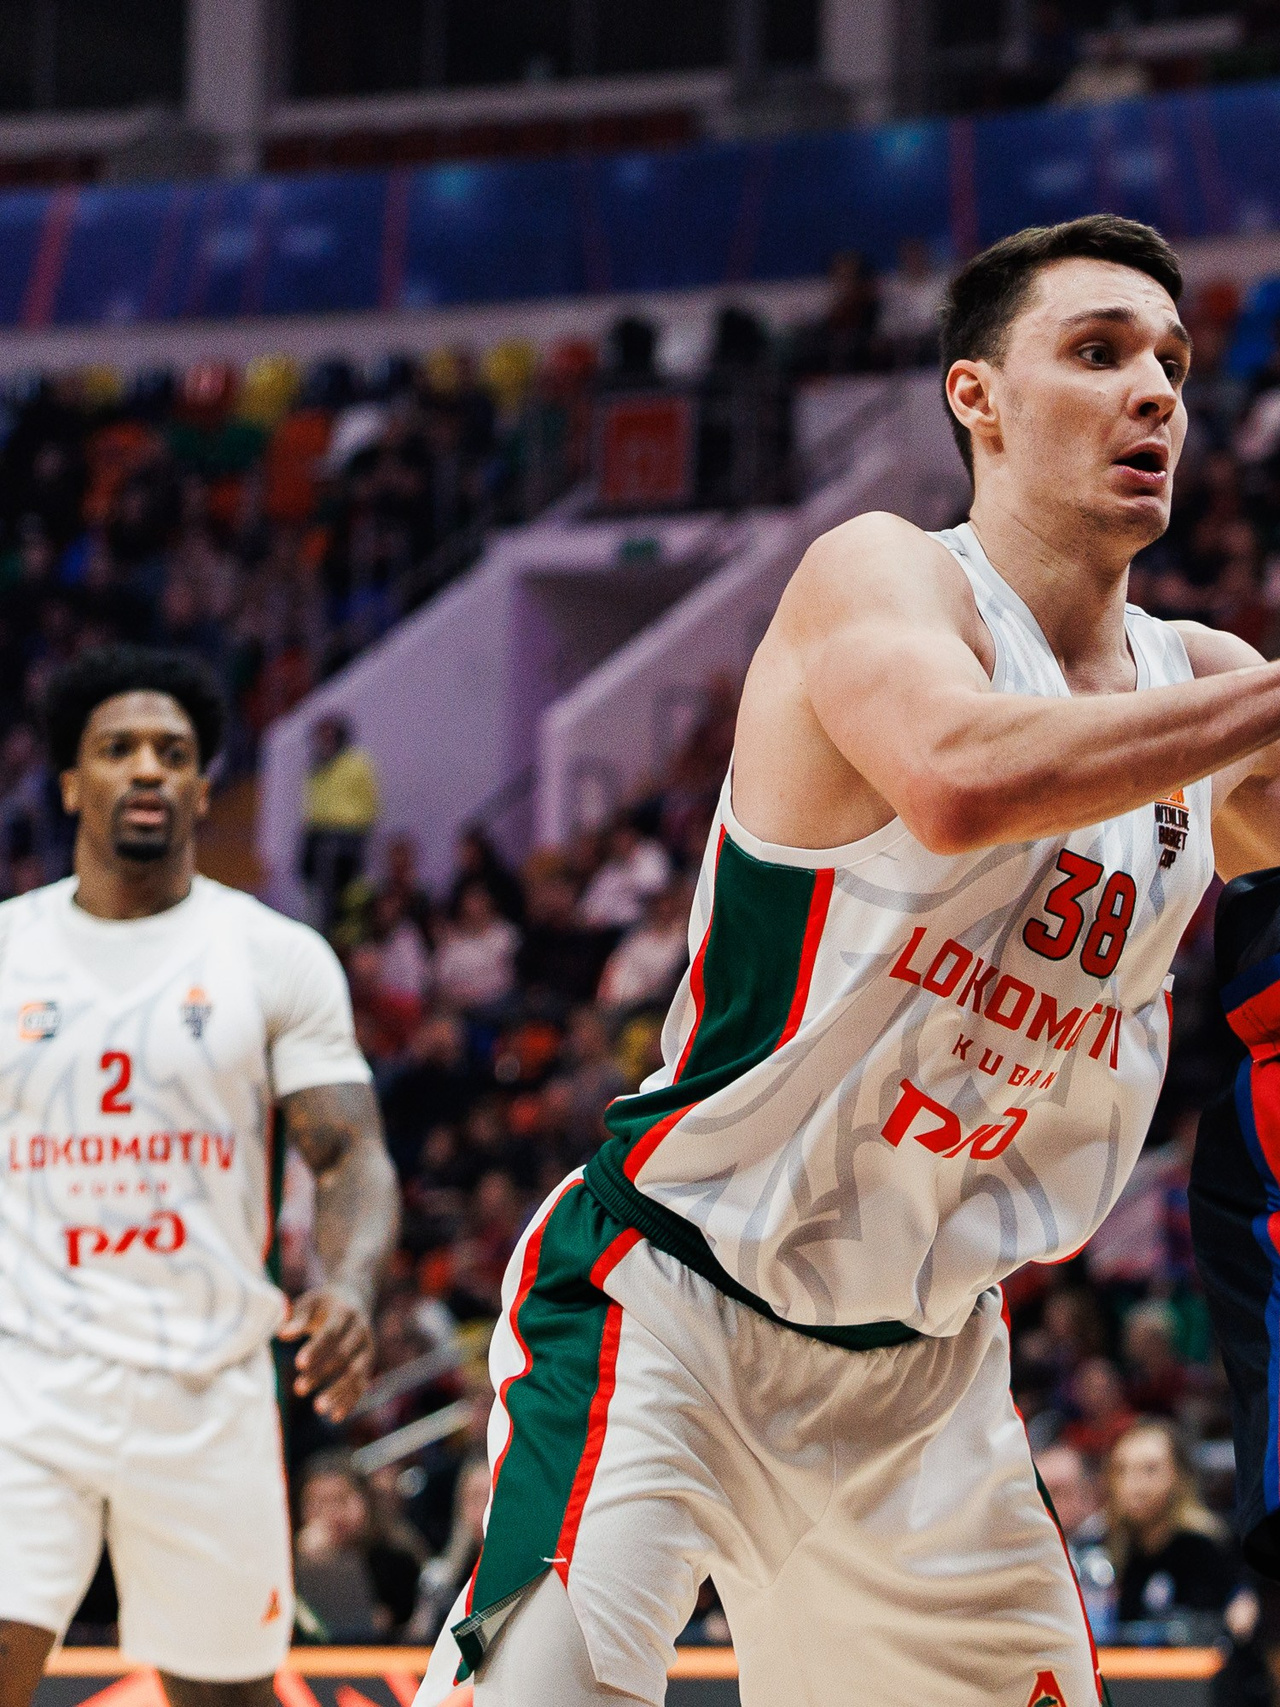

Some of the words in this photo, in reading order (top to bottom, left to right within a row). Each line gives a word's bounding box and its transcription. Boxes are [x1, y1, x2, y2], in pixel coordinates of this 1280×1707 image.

[1022, 848, 1137, 979] 38
[99, 1051, 132, 1115] 2
[951, 1033, 1058, 1090] KUBAN
[9, 1130, 235, 1173] LOKOMOTIV
